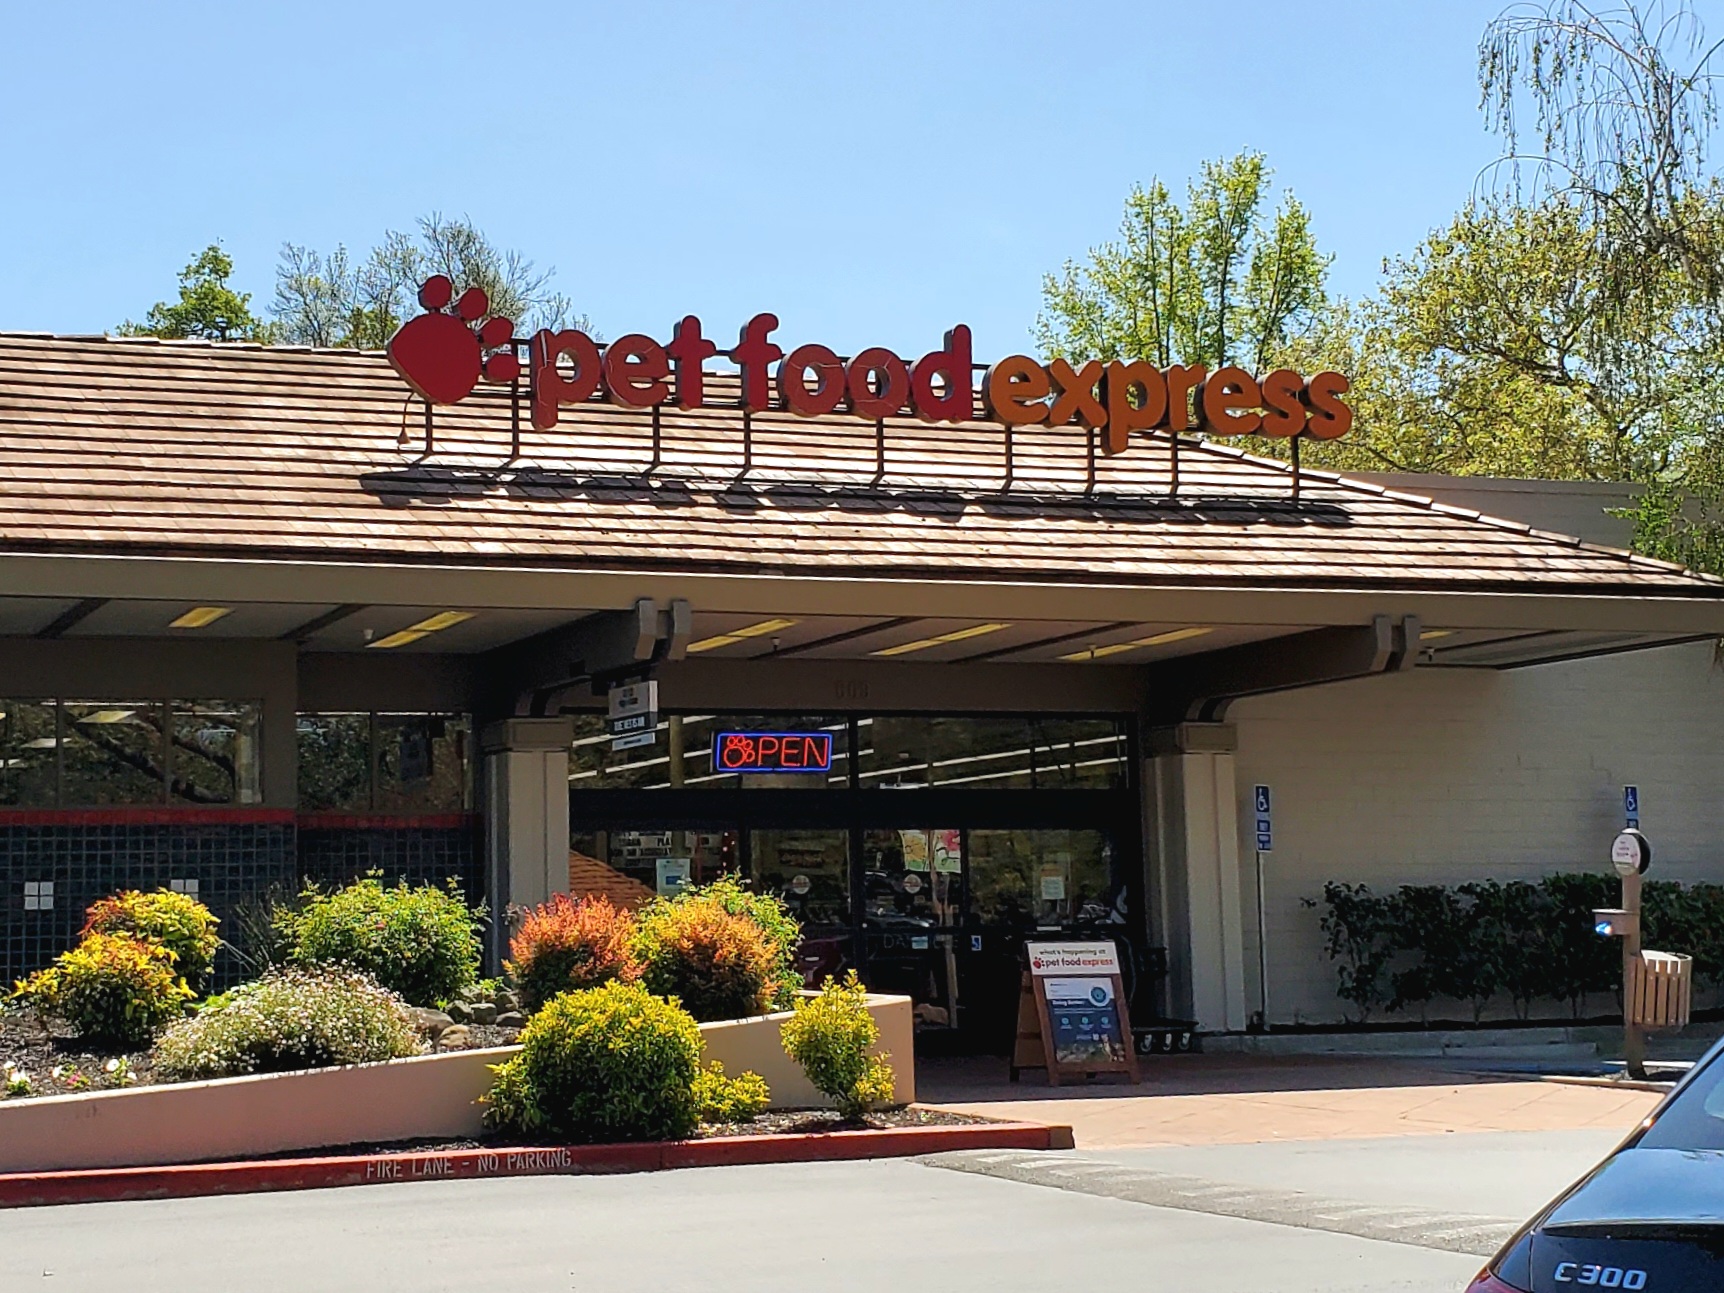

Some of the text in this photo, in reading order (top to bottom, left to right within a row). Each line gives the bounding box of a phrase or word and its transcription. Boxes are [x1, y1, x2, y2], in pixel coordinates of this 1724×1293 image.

[531, 312, 1352, 455] pet food express
[722, 734, 829, 768] OPEN
[1045, 957, 1114, 969] pet food express
[366, 1160, 403, 1180] FIRE
[412, 1156, 454, 1176] LANE
[477, 1153, 499, 1173] NO
[507, 1147, 573, 1171] PARKING
